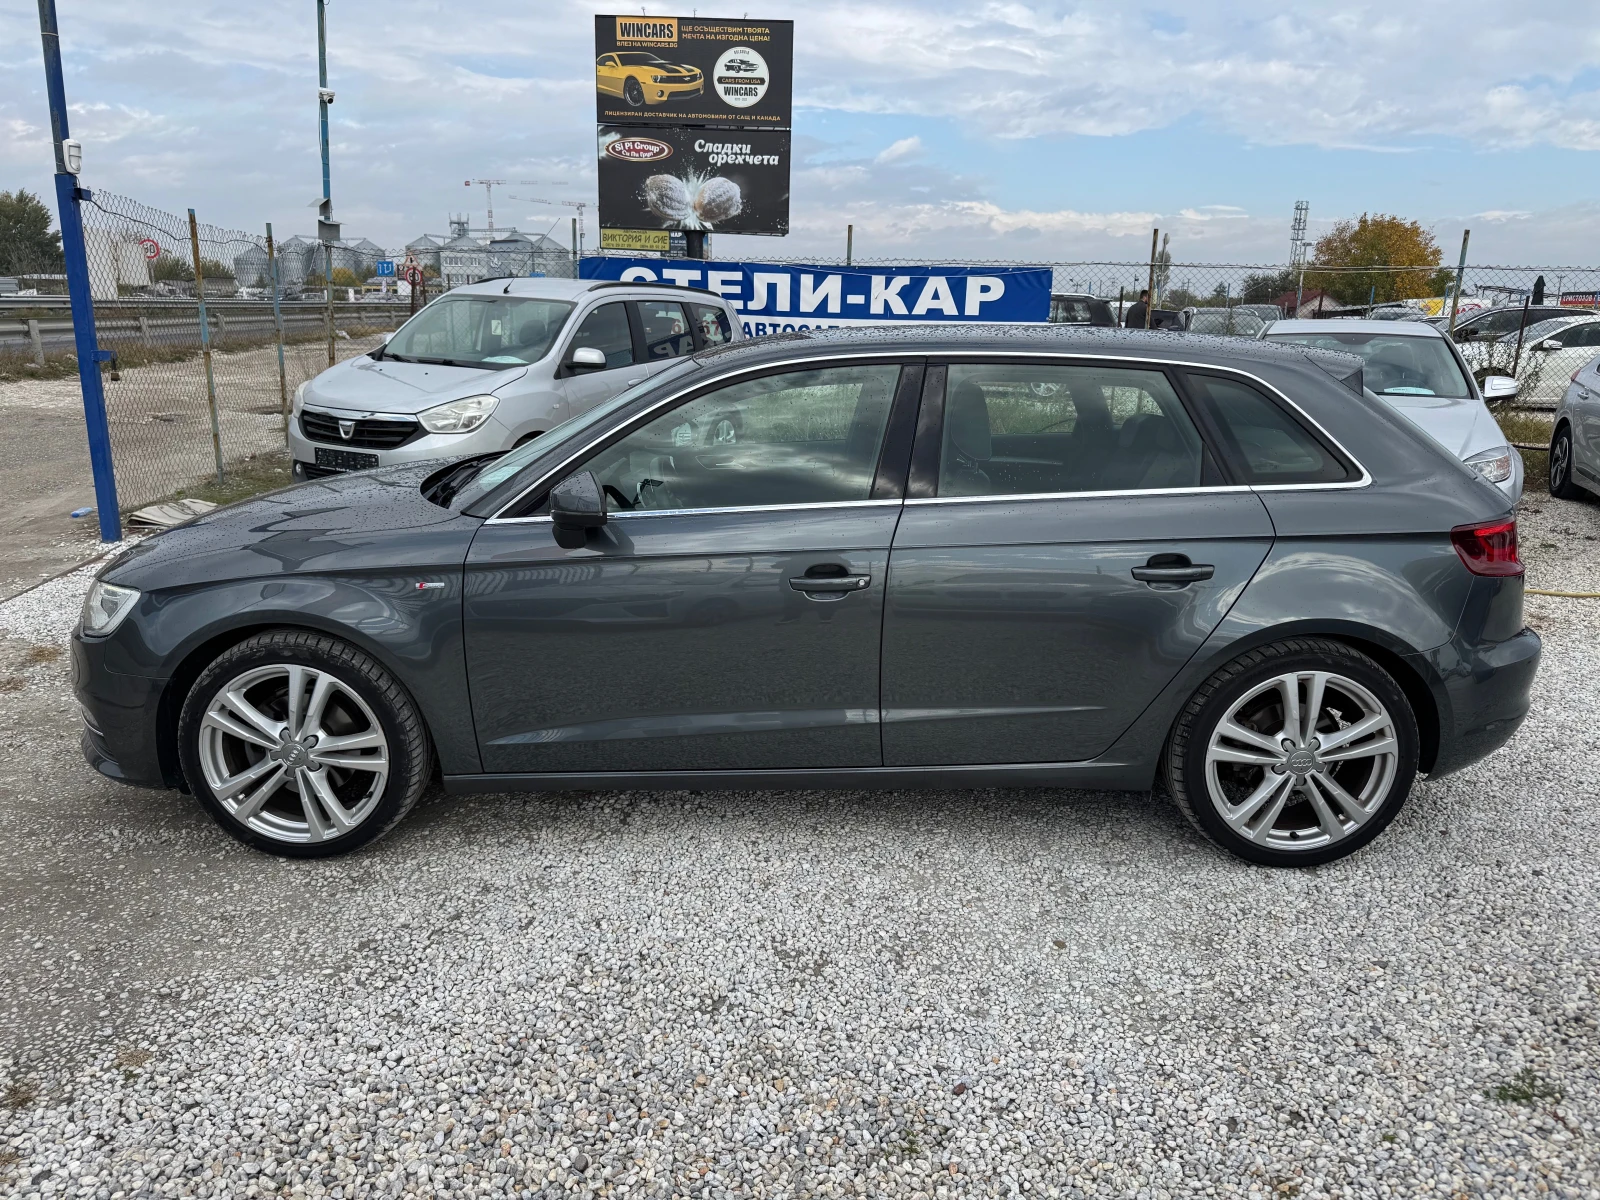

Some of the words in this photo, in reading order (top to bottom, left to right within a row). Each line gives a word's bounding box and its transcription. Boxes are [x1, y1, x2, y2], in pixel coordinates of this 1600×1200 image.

[620, 22, 673, 38] WINCARS
[723, 86, 758, 97] WINCARS
[625, 142, 633, 150] Pi
[694, 139, 752, 155] Сладки
[708, 153, 779, 167] орехчета
[602, 233, 642, 242] ВИКТОРИЯ
[644, 235, 651, 243] И
[652, 235, 668, 244] СИЕ
